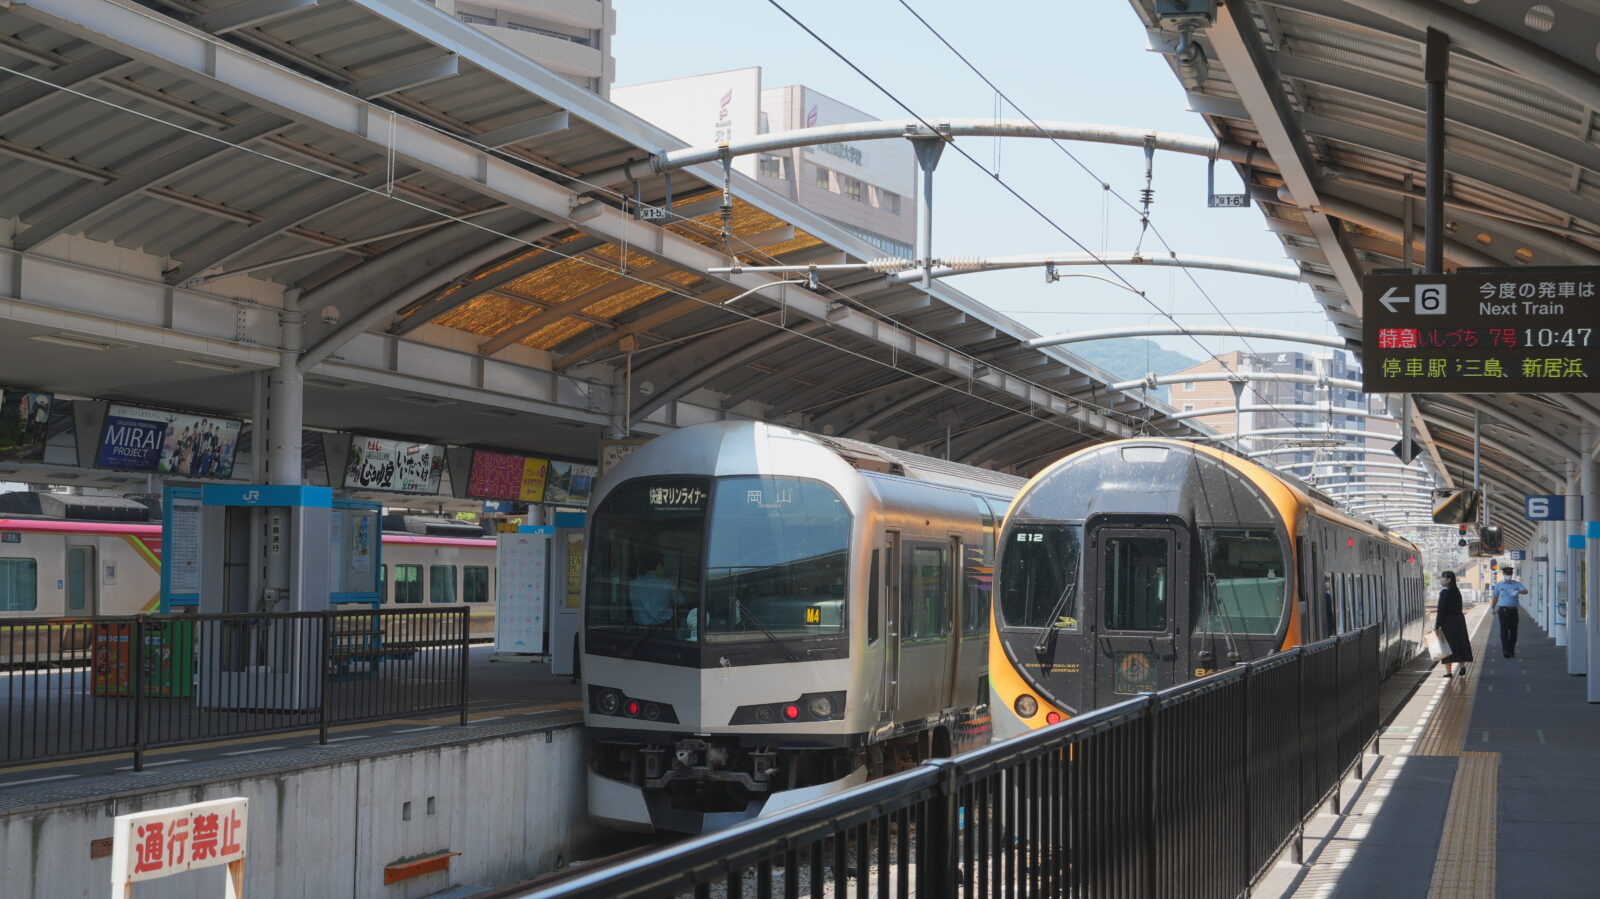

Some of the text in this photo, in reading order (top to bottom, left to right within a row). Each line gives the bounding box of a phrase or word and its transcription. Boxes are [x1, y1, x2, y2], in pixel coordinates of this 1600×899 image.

[1479, 282, 1595, 299] 今度の発車は
[1421, 288, 1440, 311] 6
[1479, 301, 1564, 315] Next Train
[1489, 328, 1518, 348] 7号
[1524, 328, 1592, 347] 10:47
[104, 425, 163, 450] MIRAI
[113, 446, 149, 458] PROJECT
[243, 490, 260, 501] JR
[649, 487, 707, 505] 快速マリンライナー
[747, 489, 792, 504] 岡山
[1528, 497, 1549, 518] 6
[1016, 532, 1043, 543] E12
[1511, 551, 1520, 559] 6
[806, 608, 820, 623] M4
[135, 808, 242, 874] 通行禁止
